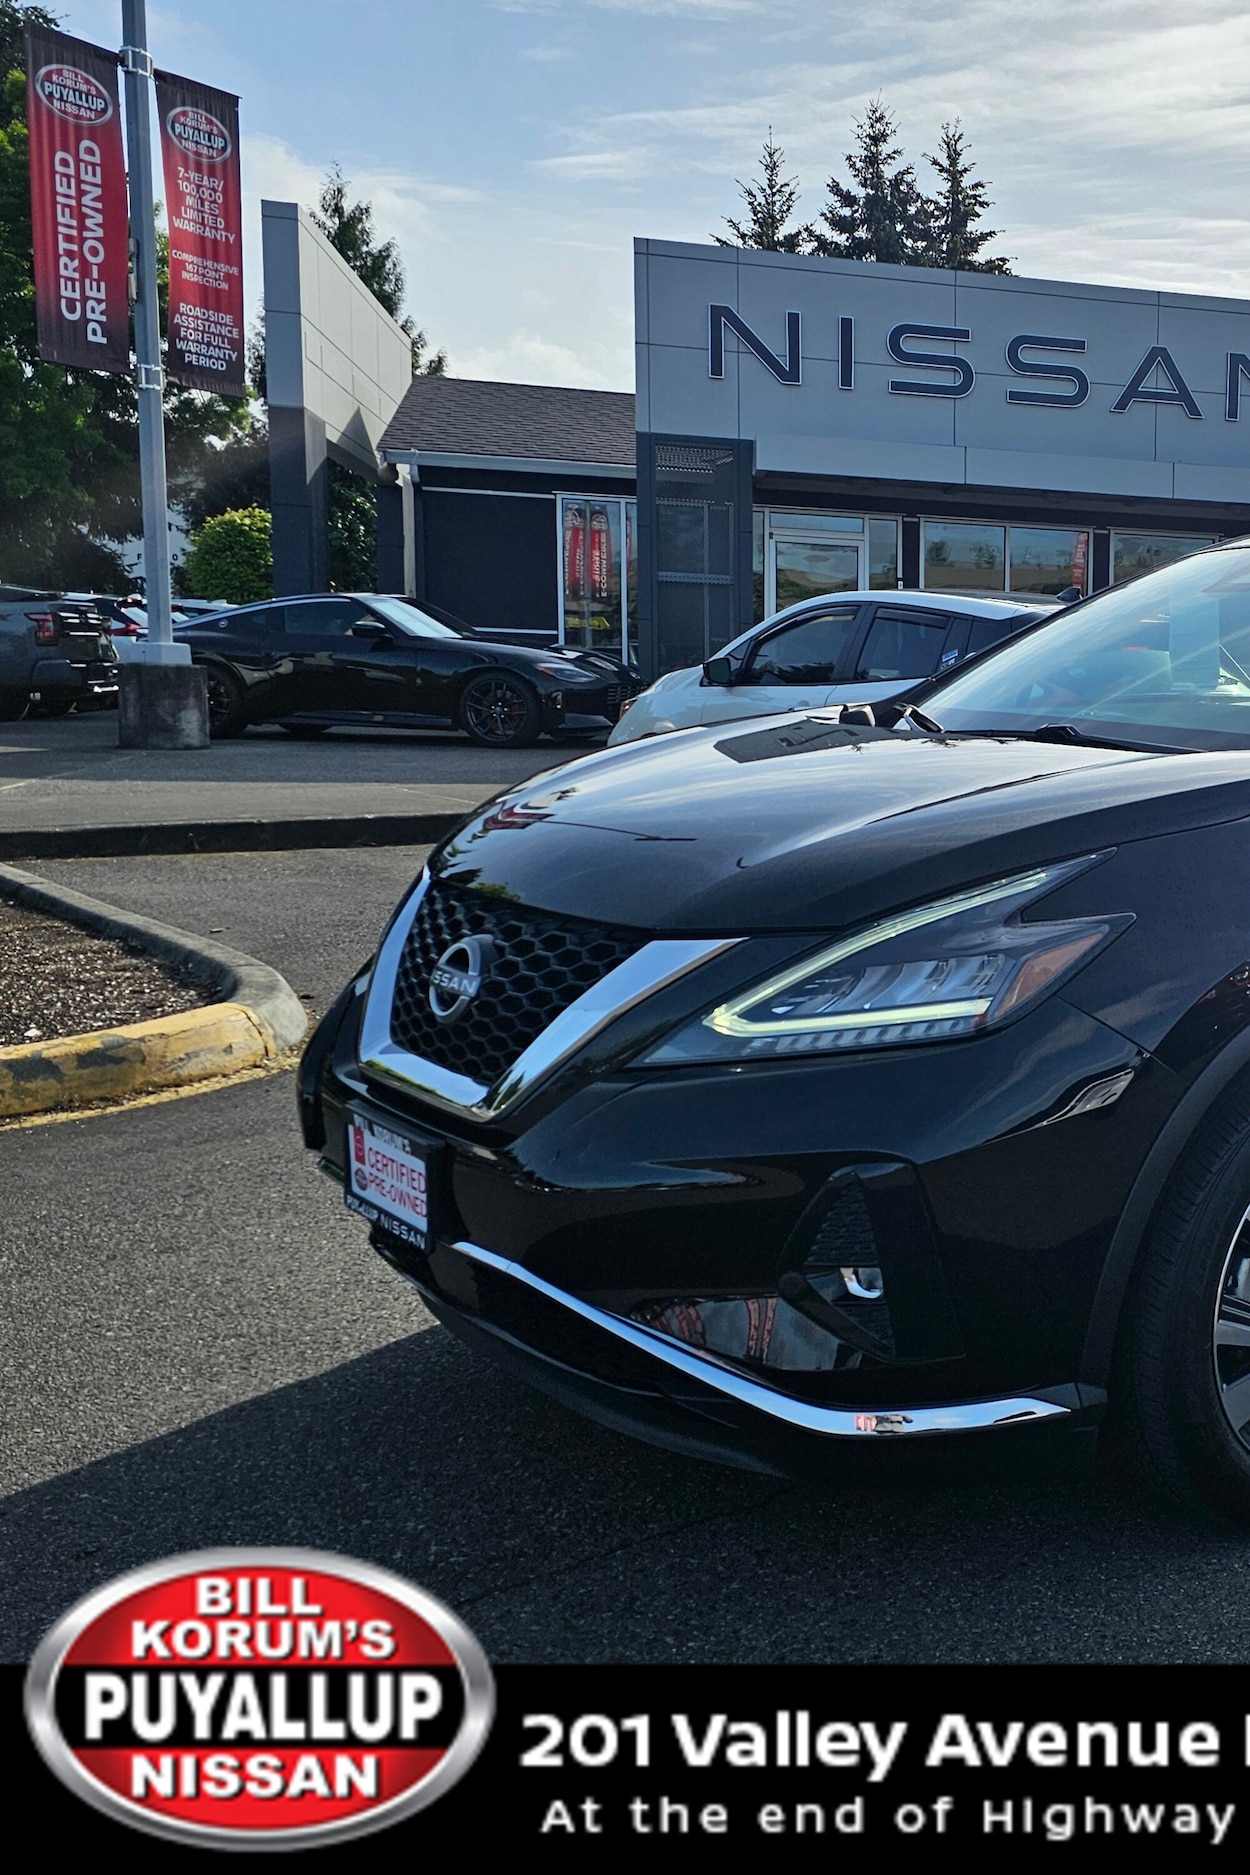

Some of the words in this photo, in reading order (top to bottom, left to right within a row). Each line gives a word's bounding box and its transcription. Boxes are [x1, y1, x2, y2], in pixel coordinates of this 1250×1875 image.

[52, 73, 97, 95] KORUM'S
[63, 69, 84, 83] BILL
[44, 81, 105, 111] PUYALLUP
[53, 98, 95, 119] NISSAN
[188, 111, 207, 124] BILL
[174, 122, 225, 150] PUYALLUP
[180, 115, 218, 135] KORUM'S
[181, 138, 217, 157] NISSAN
[177, 166, 224, 192] 7-YEAR/
[177, 180, 223, 203] 100,000
[185, 195, 219, 215] MILES
[181, 206, 225, 229] LIMITED
[54, 150, 82, 321] CERTIFIED
[172, 216, 236, 244] WARRANTY
[79, 139, 108, 345] PRE-OWNED
[172, 249, 240, 276] COMPREHENSIVE
[198, 266, 225, 281] POINT
[181, 270, 229, 291] INSPECTION
[179, 302, 234, 326] ROADSIDE
[173, 313, 240, 339] ASSISTANCE
[180, 327, 203, 343] FOR
[203, 332, 231, 349] FULL
[175, 338, 238, 362] WARRANTY
[184, 352, 227, 371] PERIOD
[432, 970, 476, 993] SSAN
[367, 1146, 427, 1194] CERTIFIED
[368, 1171, 428, 1218] PRE-OWNED
[380, 1213, 427, 1250] NISSAN
